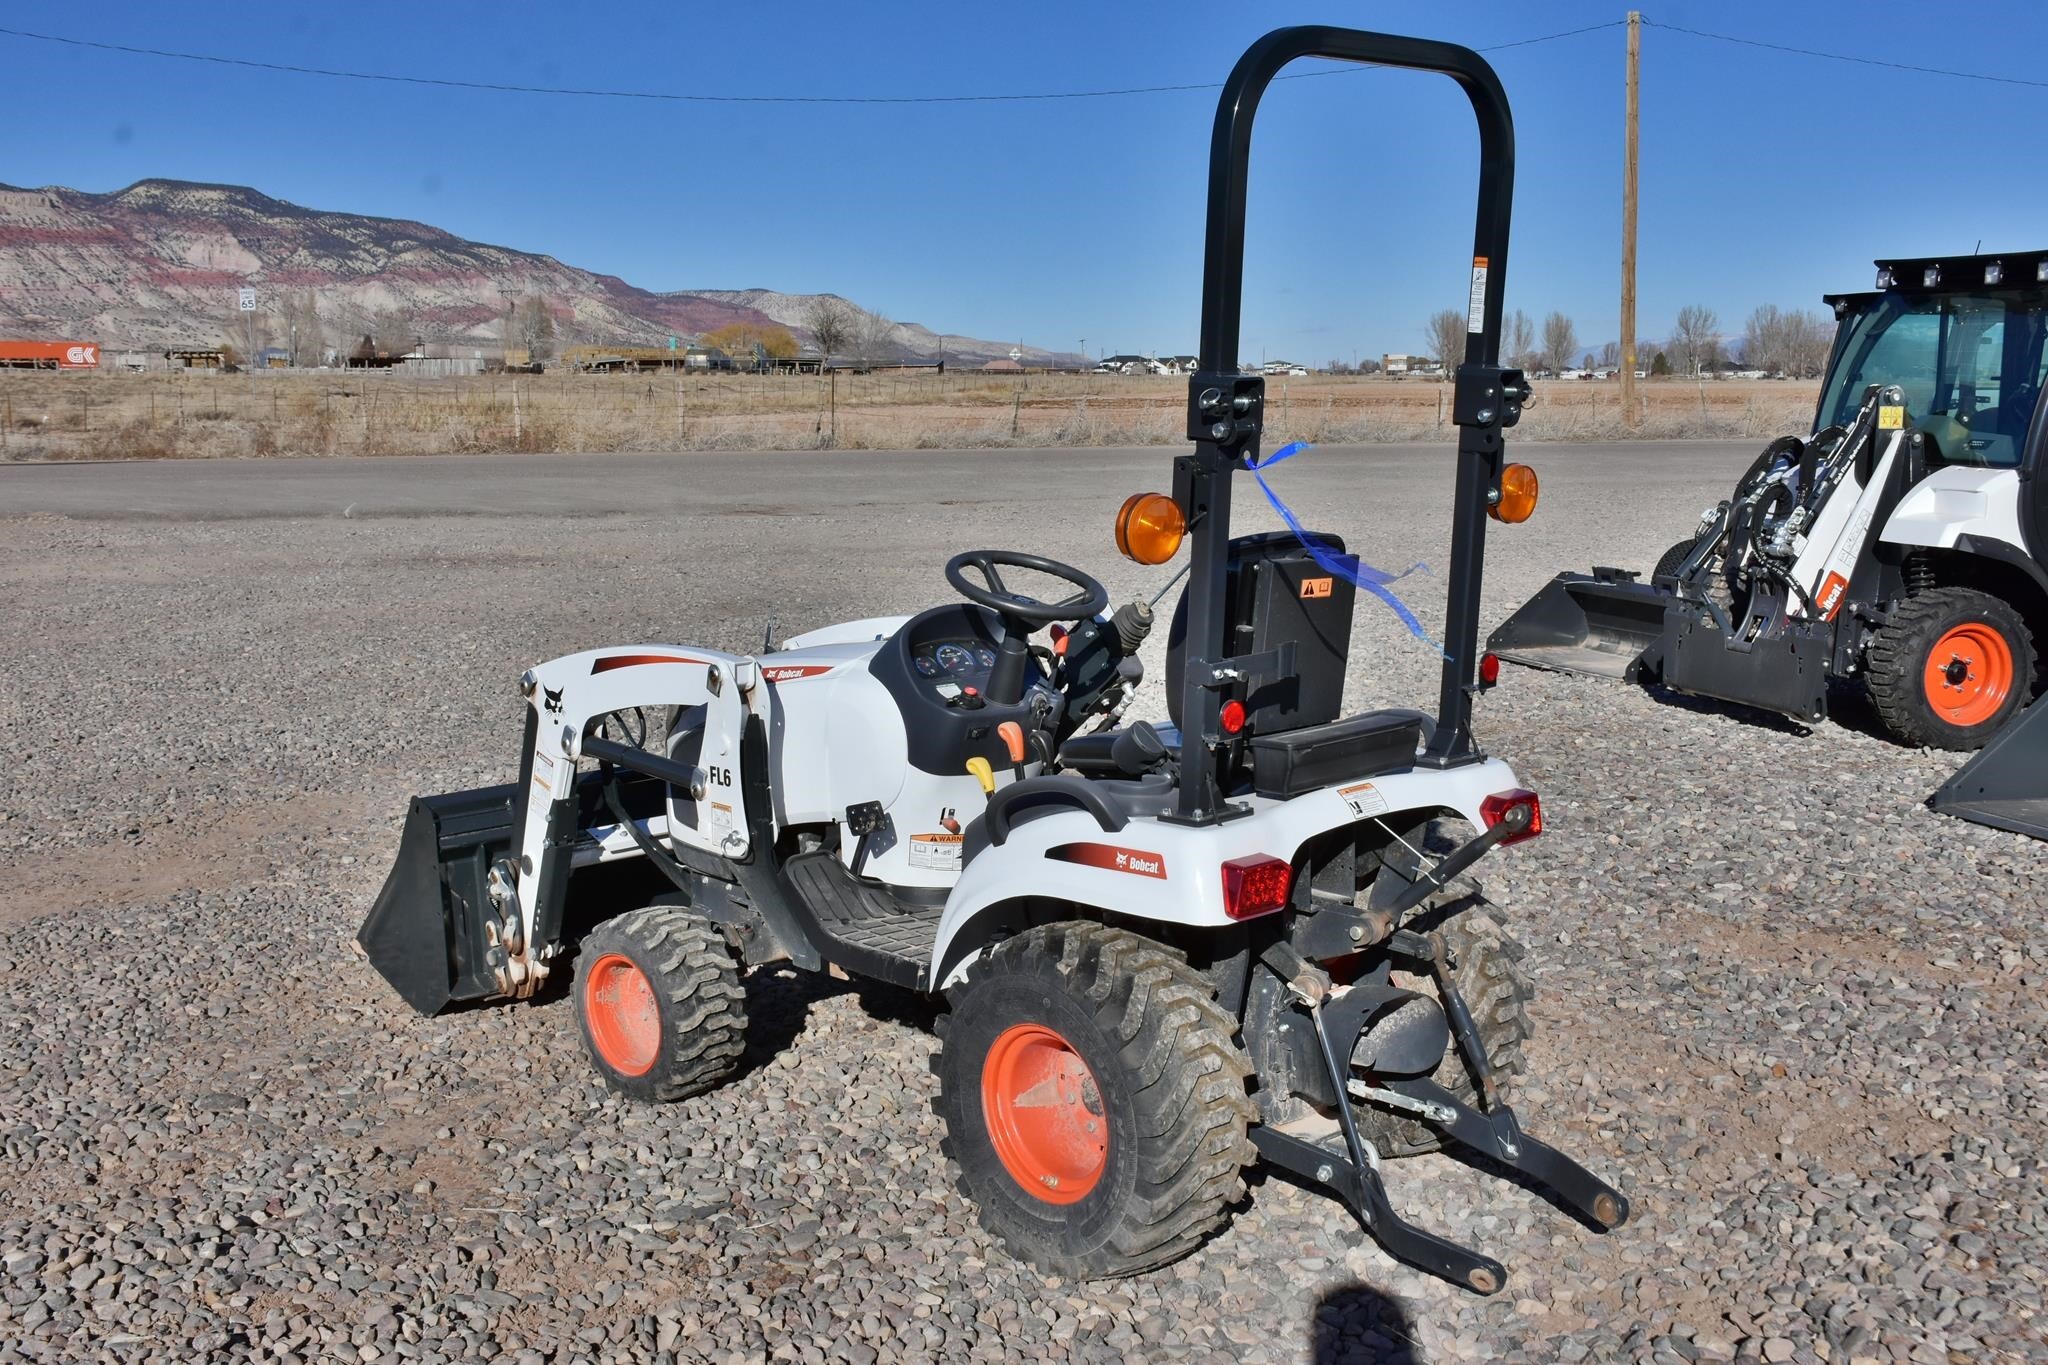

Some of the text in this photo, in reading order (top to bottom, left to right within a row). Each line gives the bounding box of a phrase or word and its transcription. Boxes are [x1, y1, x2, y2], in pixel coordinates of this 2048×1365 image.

[242, 300, 254, 308] 65
[67, 347, 96, 363] GK
[777, 669, 804, 679] Bobcat
[710, 766, 731, 787] FL6
[939, 835, 964, 843] WARN
[1130, 857, 1159, 874] Bobcat
